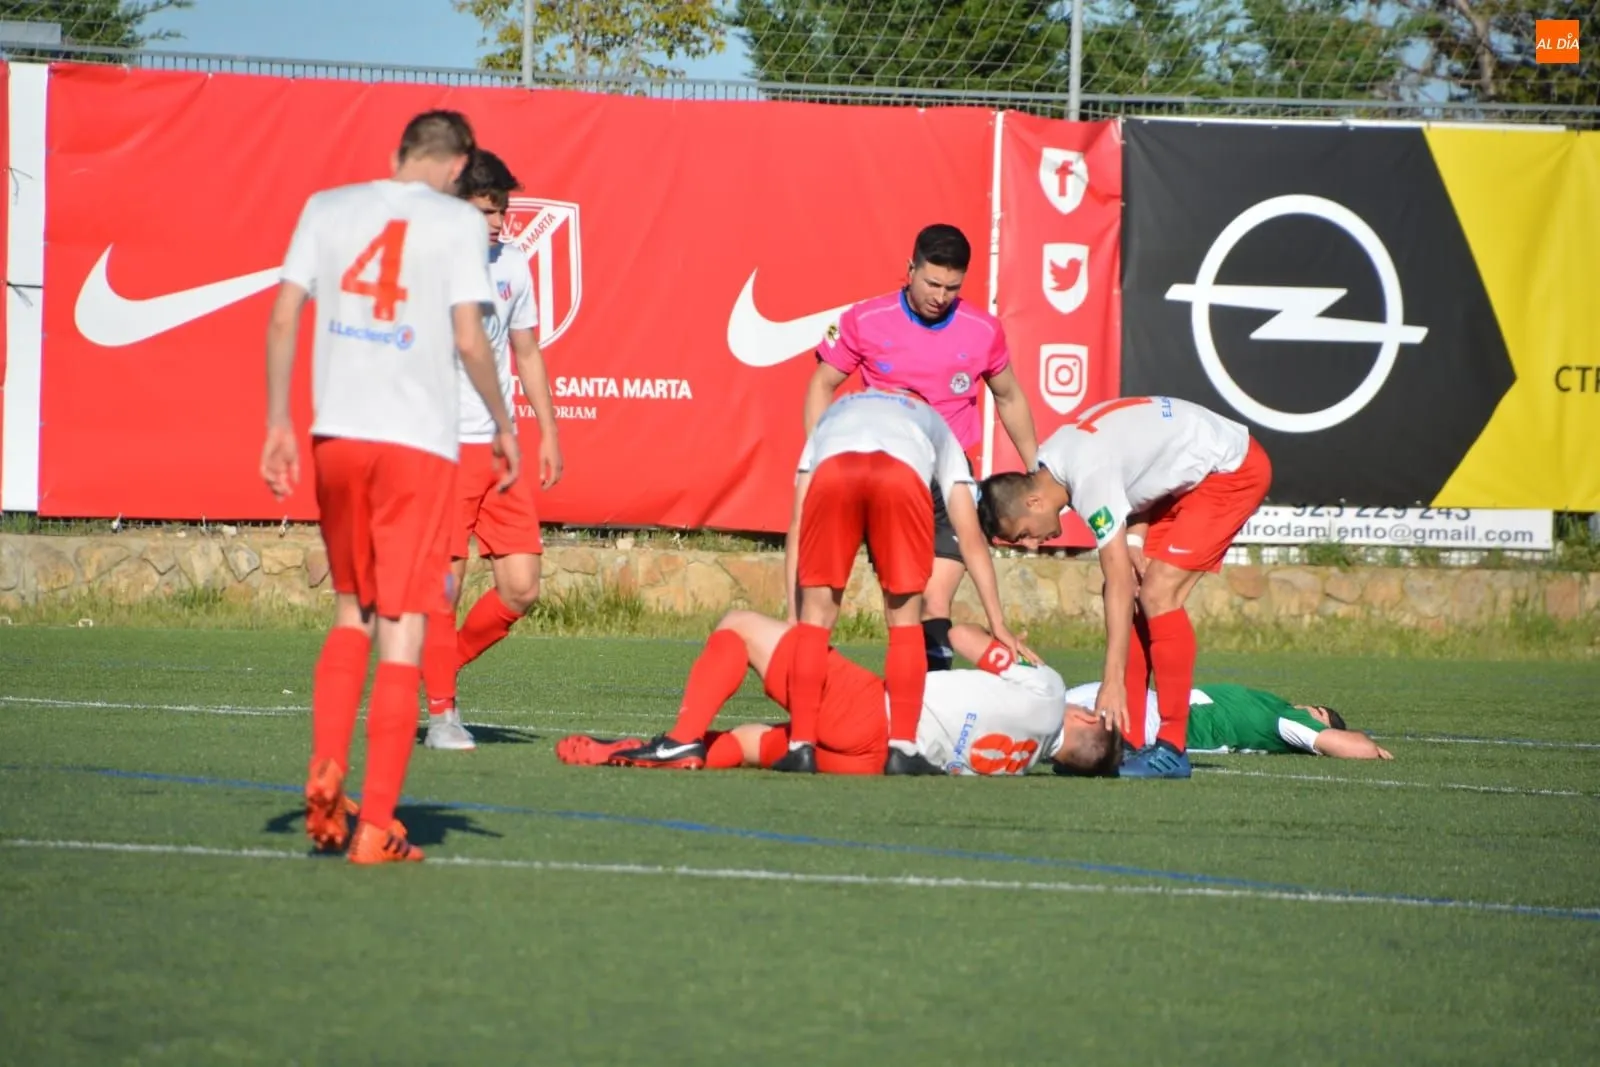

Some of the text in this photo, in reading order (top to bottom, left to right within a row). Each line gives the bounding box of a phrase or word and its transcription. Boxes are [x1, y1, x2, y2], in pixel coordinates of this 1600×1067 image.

[526, 212, 556, 247] MARTA
[340, 219, 409, 321] 4
[555, 376, 619, 397] SANTA
[623, 378, 693, 399] MARTA
[969, 733, 1038, 775] 8
